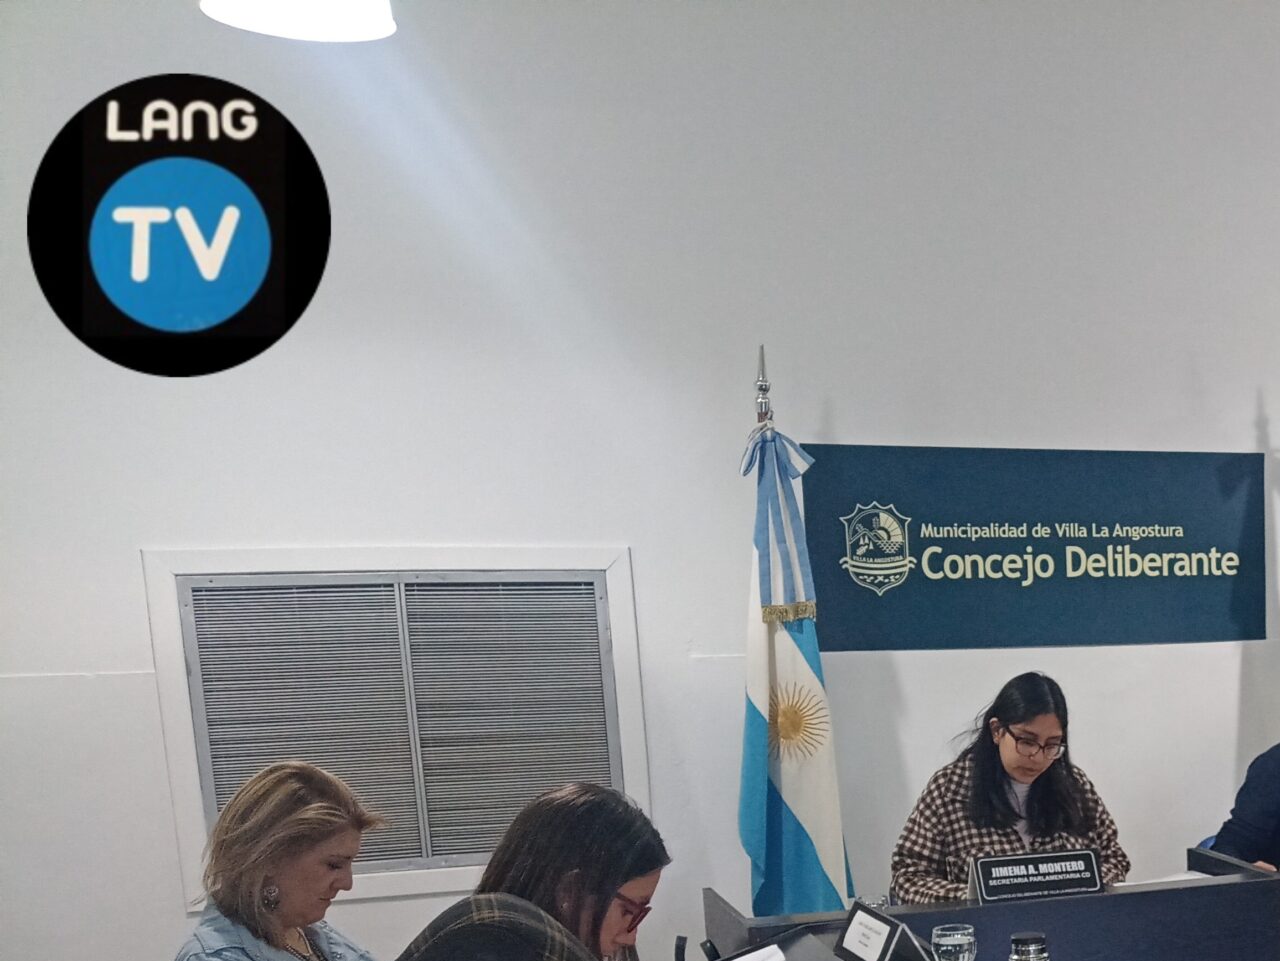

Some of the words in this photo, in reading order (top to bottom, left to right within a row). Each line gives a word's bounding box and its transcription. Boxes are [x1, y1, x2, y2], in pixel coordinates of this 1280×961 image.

[920, 523, 1027, 541] Municipalidad
[1032, 523, 1051, 538] de
[1055, 523, 1088, 538] Villa
[1092, 523, 1109, 538] La
[1112, 523, 1184, 541] Angostura
[921, 545, 1055, 587] Concejo
[1066, 544, 1240, 578] Deliberante
[991, 864, 1027, 878] JIMENA
[1028, 864, 1038, 875] A.
[1039, 860, 1085, 873] MONTERO
[988, 877, 1029, 886] SECRETARIA
[1029, 873, 1081, 883] PARLAMENTARIA
